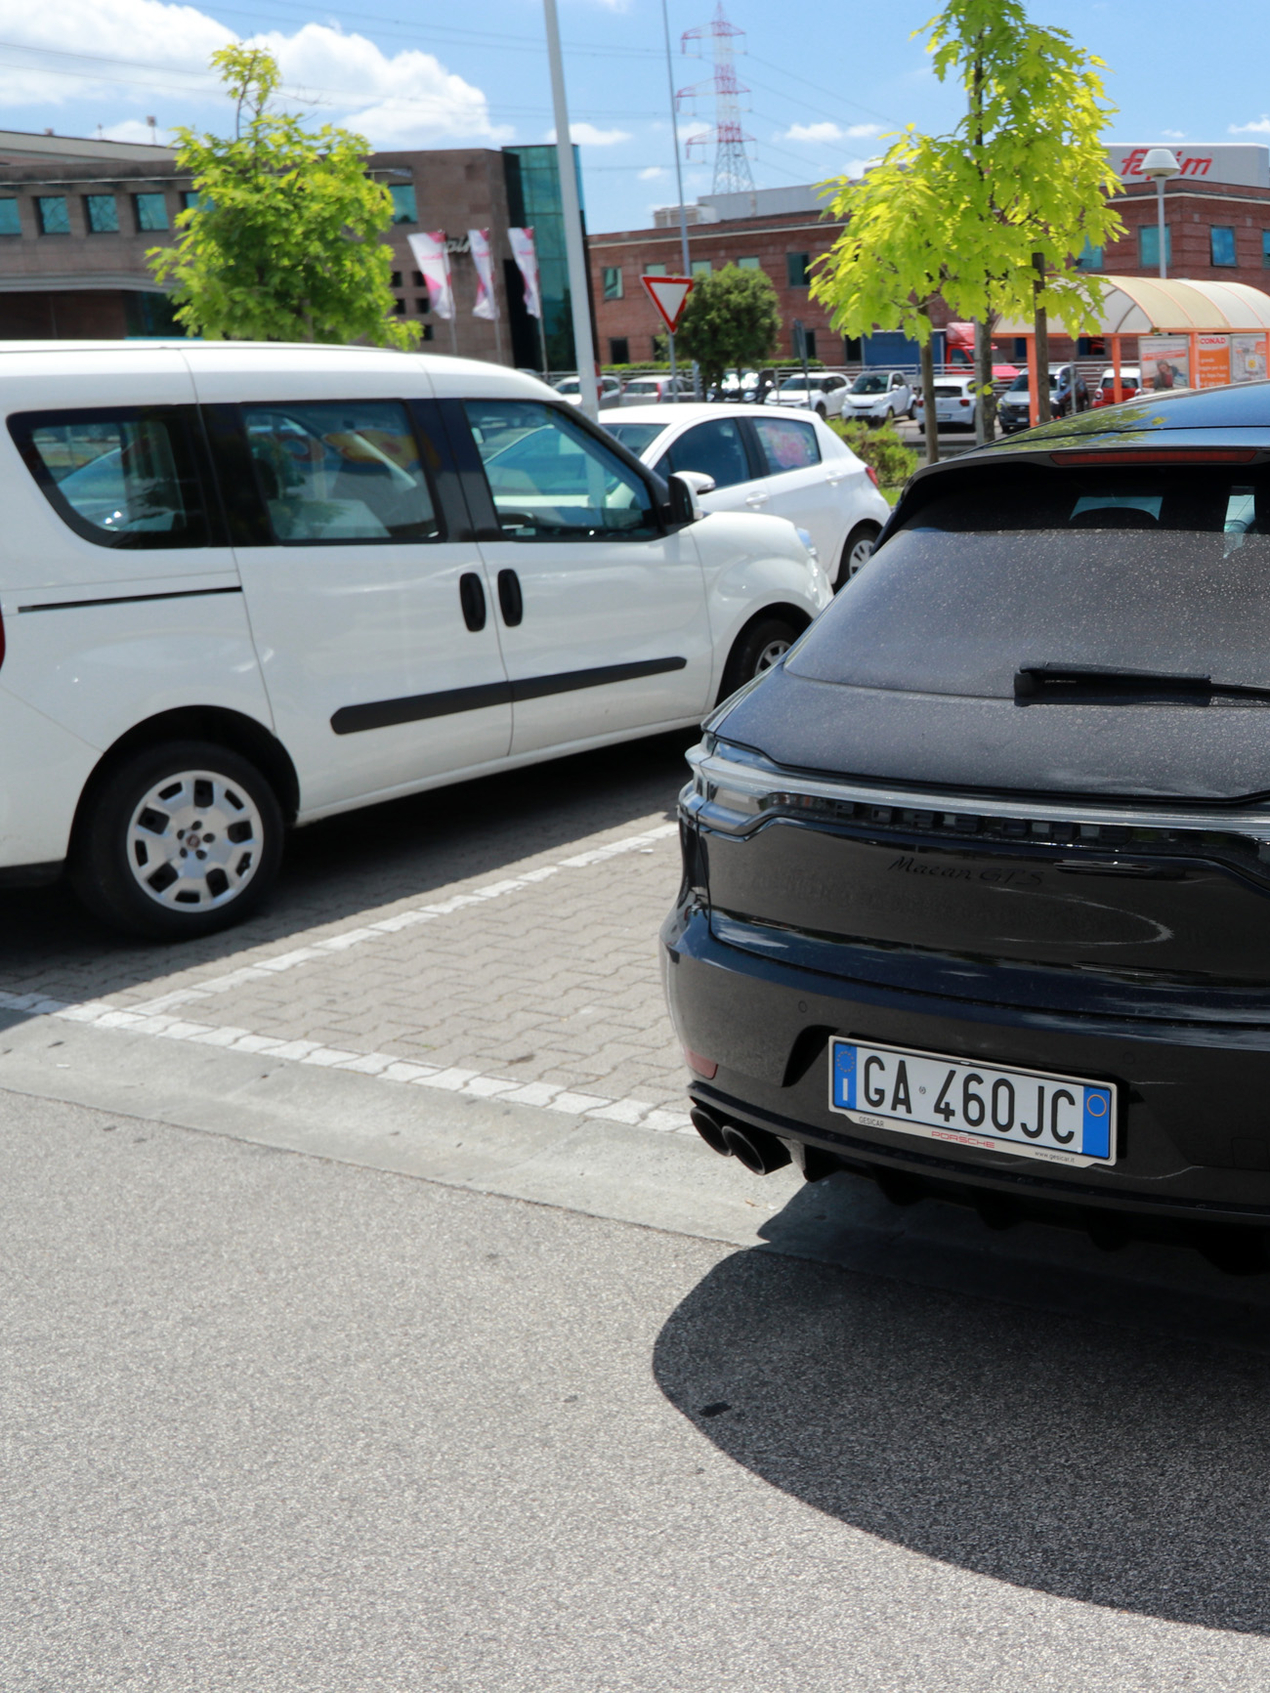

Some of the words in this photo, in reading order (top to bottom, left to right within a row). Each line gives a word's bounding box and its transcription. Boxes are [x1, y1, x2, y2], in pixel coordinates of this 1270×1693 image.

[1200, 337, 1226, 345] CONAD
[978, 866, 1045, 886] GTS
[863, 1055, 912, 1114] GA
[933, 1069, 1076, 1144] 460JC
[858, 1115, 885, 1128] GESICAR
[931, 1130, 995, 1149] PORSCHE
[1034, 1149, 1075, 1163] www.gesicar.it
